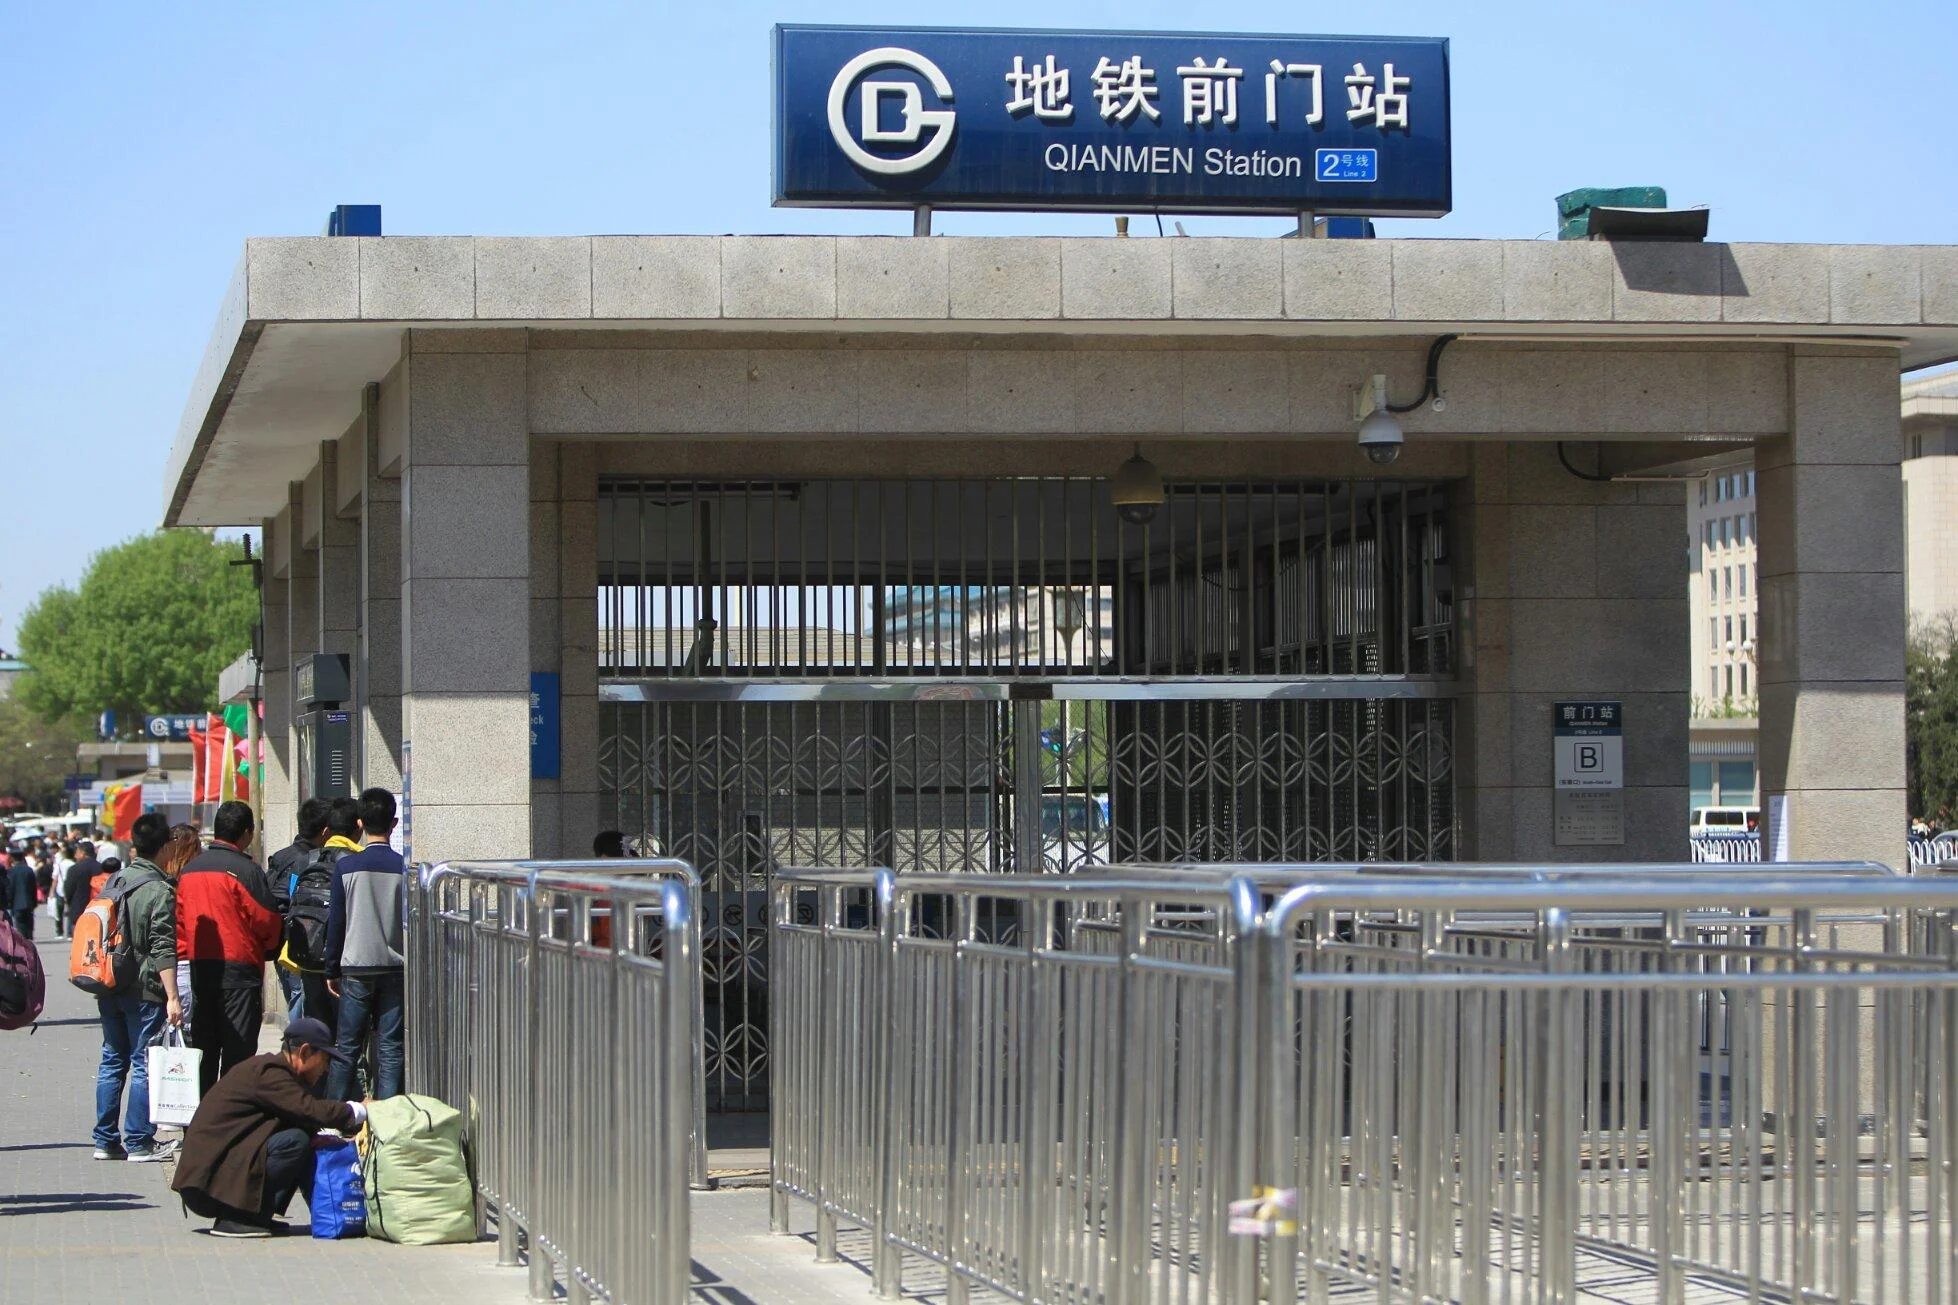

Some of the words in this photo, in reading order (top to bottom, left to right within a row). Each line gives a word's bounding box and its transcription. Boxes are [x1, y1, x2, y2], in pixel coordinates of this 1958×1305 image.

[1004, 54, 1411, 128] 地铁前门站
[1043, 142, 1194, 175] QIANMEN
[1203, 148, 1302, 178] Station
[1563, 706, 1613, 719] 前门站
[1581, 747, 1597, 768] B
